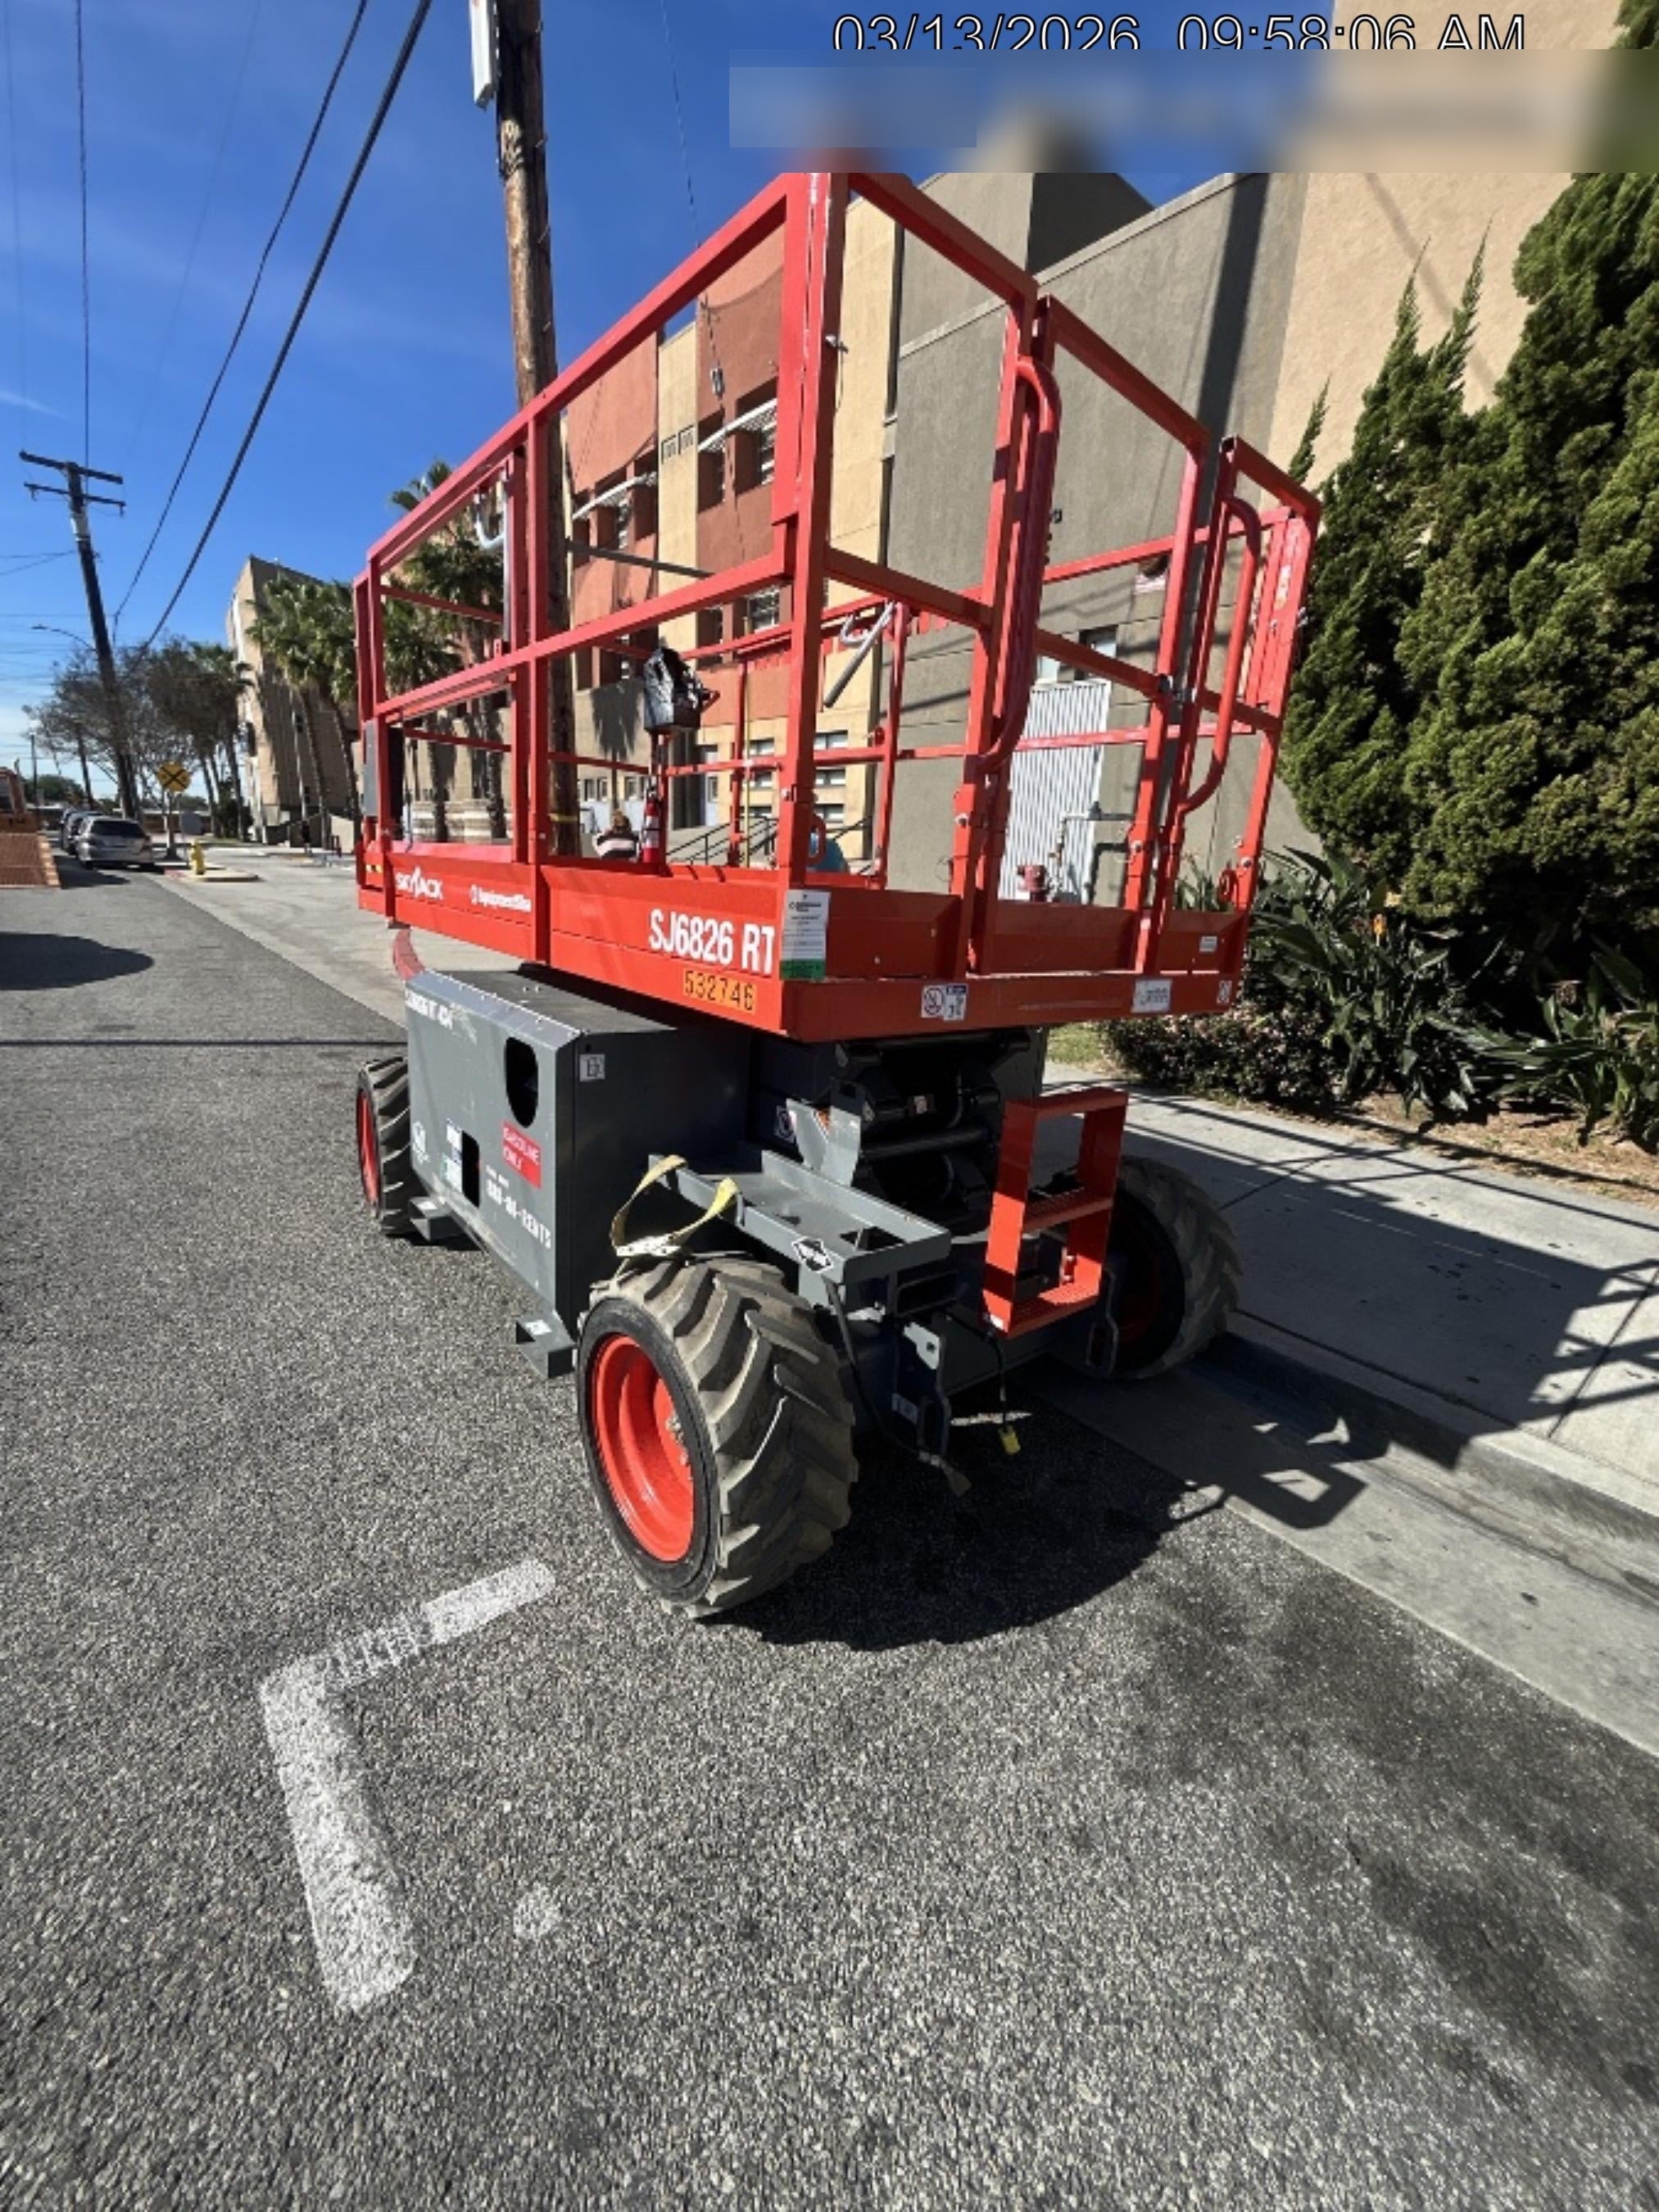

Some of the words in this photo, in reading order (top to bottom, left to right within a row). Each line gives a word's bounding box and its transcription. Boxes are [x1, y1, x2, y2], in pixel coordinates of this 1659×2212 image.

[648, 908, 735, 966] SJ6826
[741, 922, 776, 975] RT
[685, 969, 755, 1011] 532746
